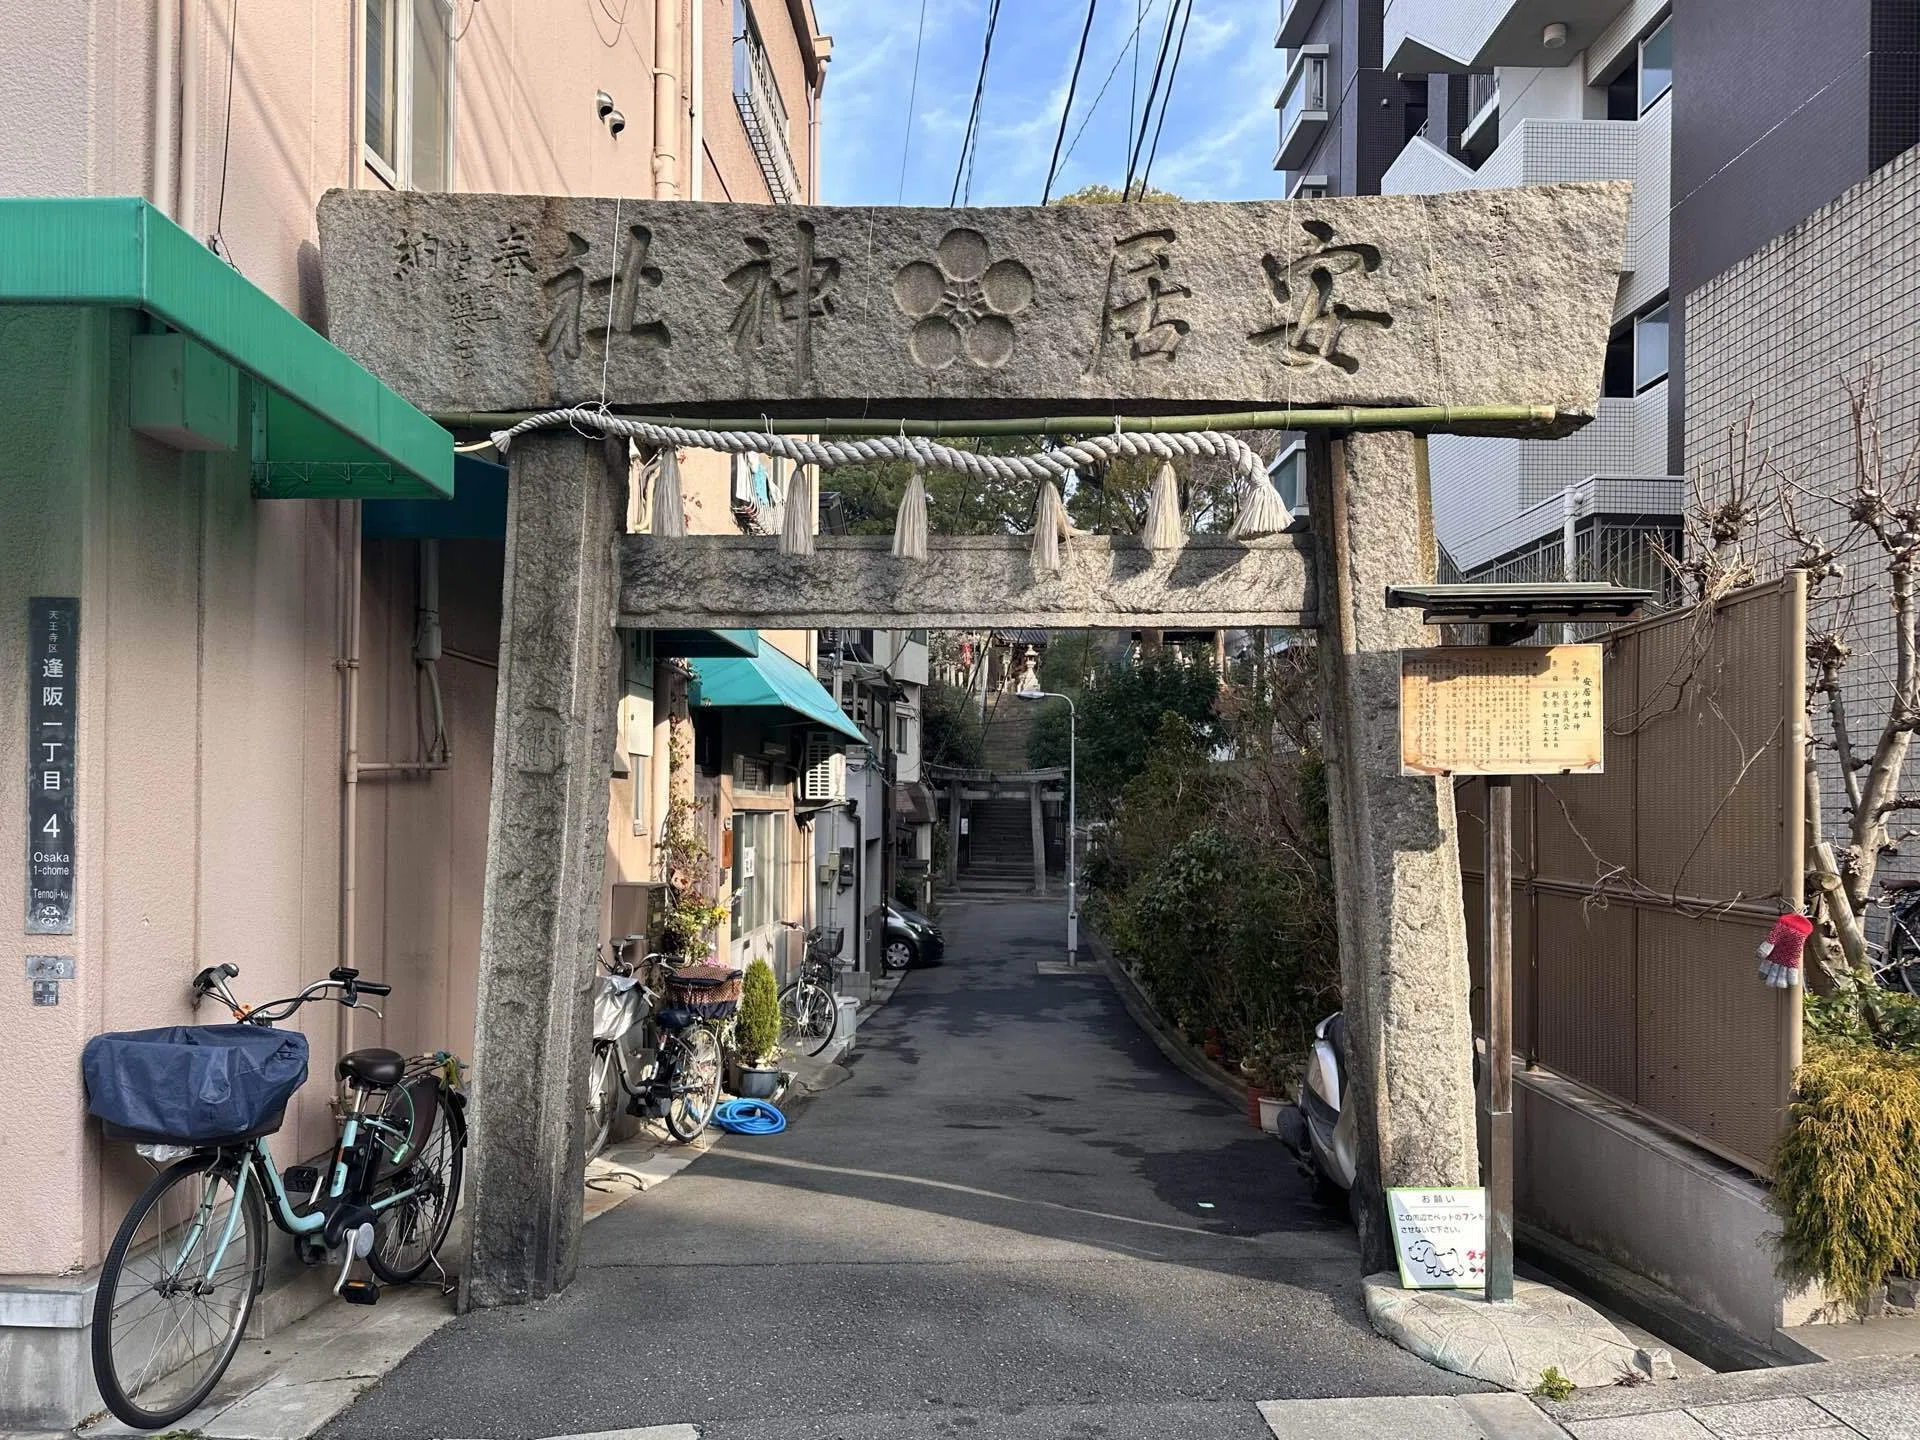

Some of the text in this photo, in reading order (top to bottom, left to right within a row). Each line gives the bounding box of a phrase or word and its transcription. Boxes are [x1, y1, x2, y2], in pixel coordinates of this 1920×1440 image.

[48, 610, 59, 653] 天王寺区
[1583, 677, 1592, 718] 安居神社
[42, 658, 64, 790] 逢阪一丁目
[33, 865, 70, 876] 1-chome
[34, 852, 70, 863] Osaka
[33, 888, 69, 900] Tennoji-ku
